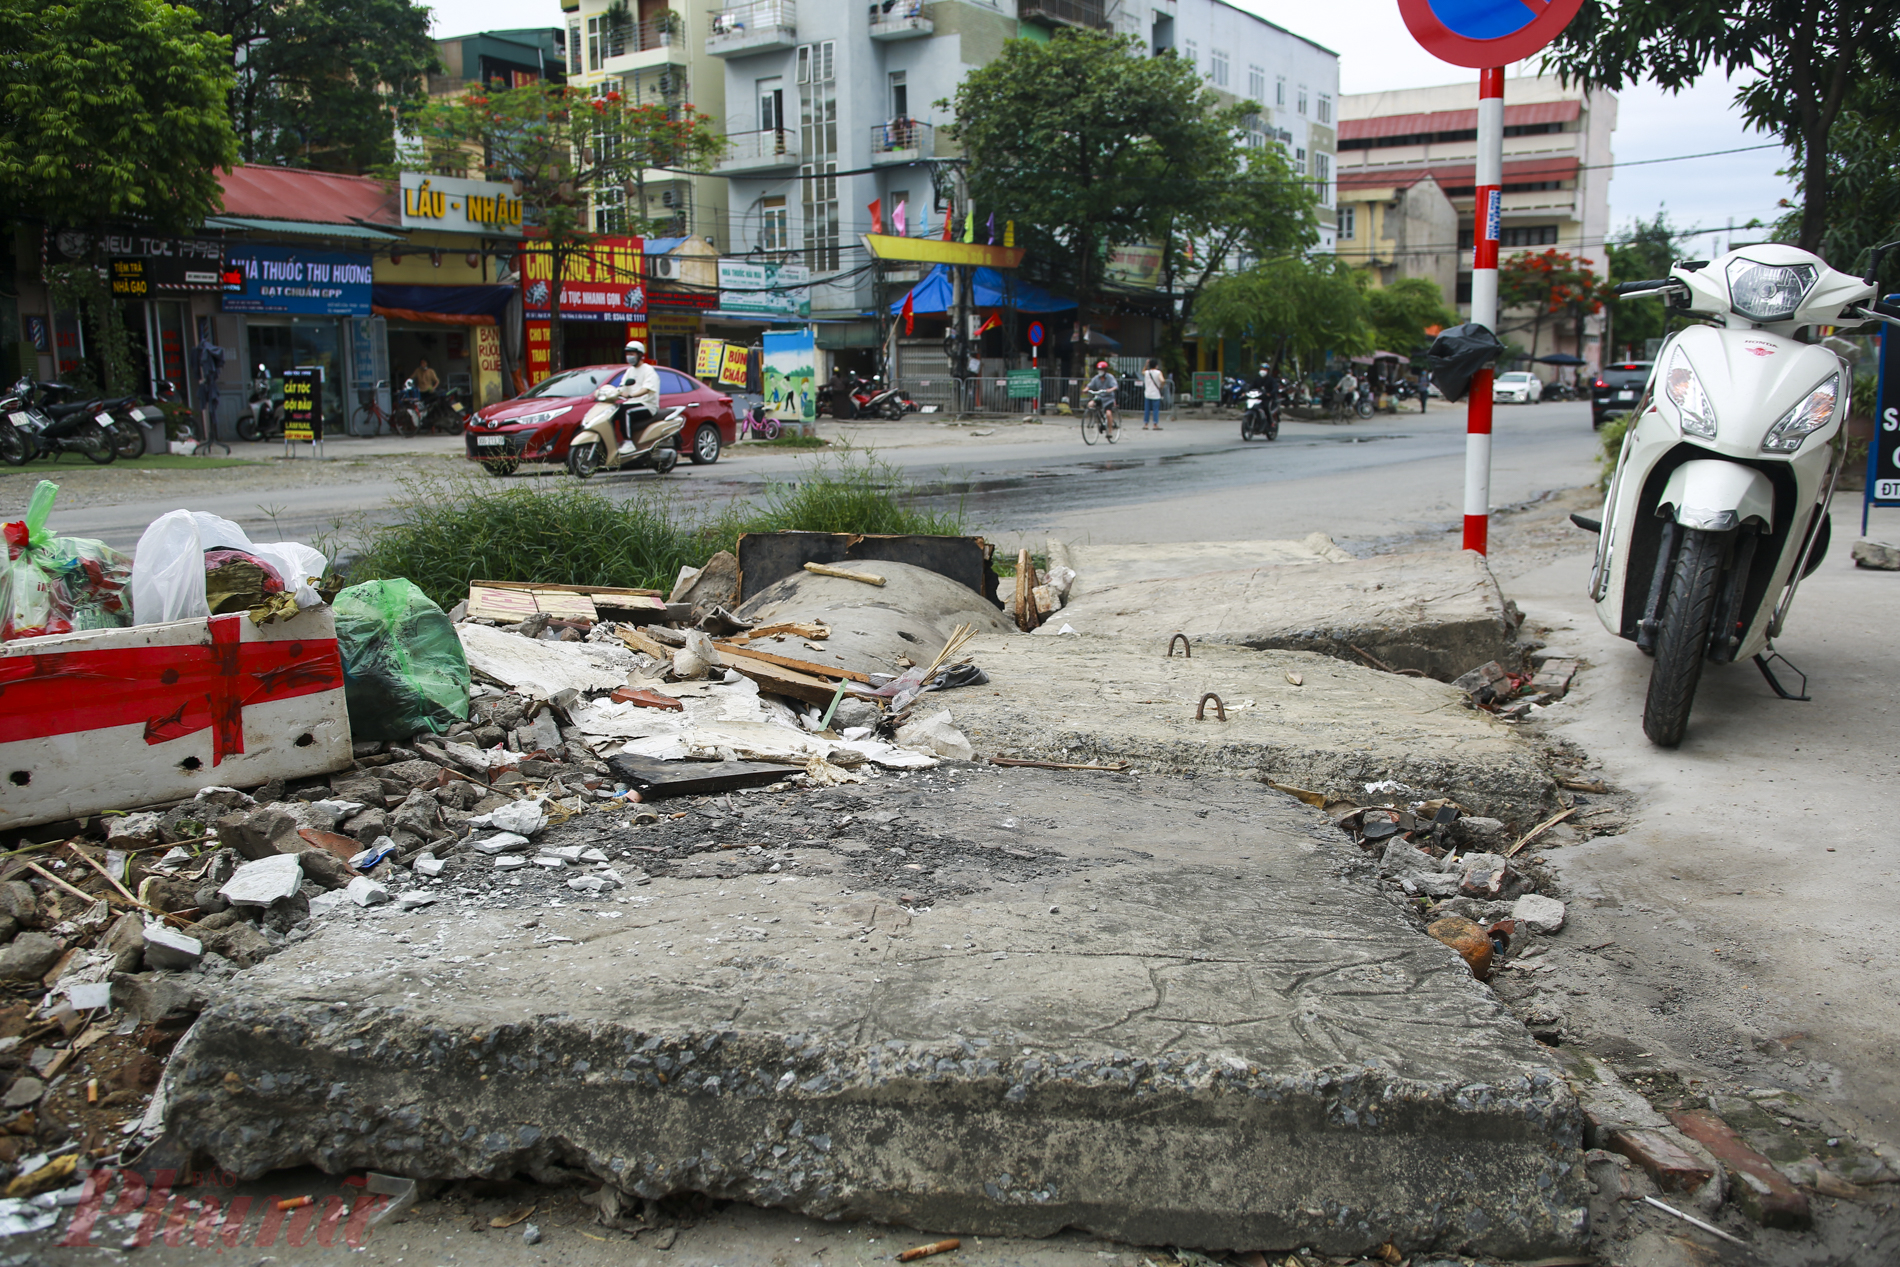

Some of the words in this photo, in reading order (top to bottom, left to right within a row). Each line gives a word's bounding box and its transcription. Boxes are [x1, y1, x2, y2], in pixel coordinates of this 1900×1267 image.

[406, 179, 446, 218] LẨU
[467, 193, 522, 231] NHẬU
[262, 255, 303, 282] THUỐC
[307, 263, 330, 282] THU
[332, 264, 372, 284] HƯƠNG
[526, 240, 553, 281] CHO
[594, 244, 612, 284] XE
[613, 240, 641, 285] MÁY
[130, 281, 147, 296] GẠO
[260, 286, 282, 298] ĐẠT
[321, 288, 342, 298] GPP
[568, 290, 581, 307] TỤC
[582, 291, 606, 305] NHANH
[1744, 340, 1779, 348] HONDA
[728, 349, 748, 365] BÚN
[723, 367, 747, 383] CHÁO
[1882, 407, 1900, 432] S
